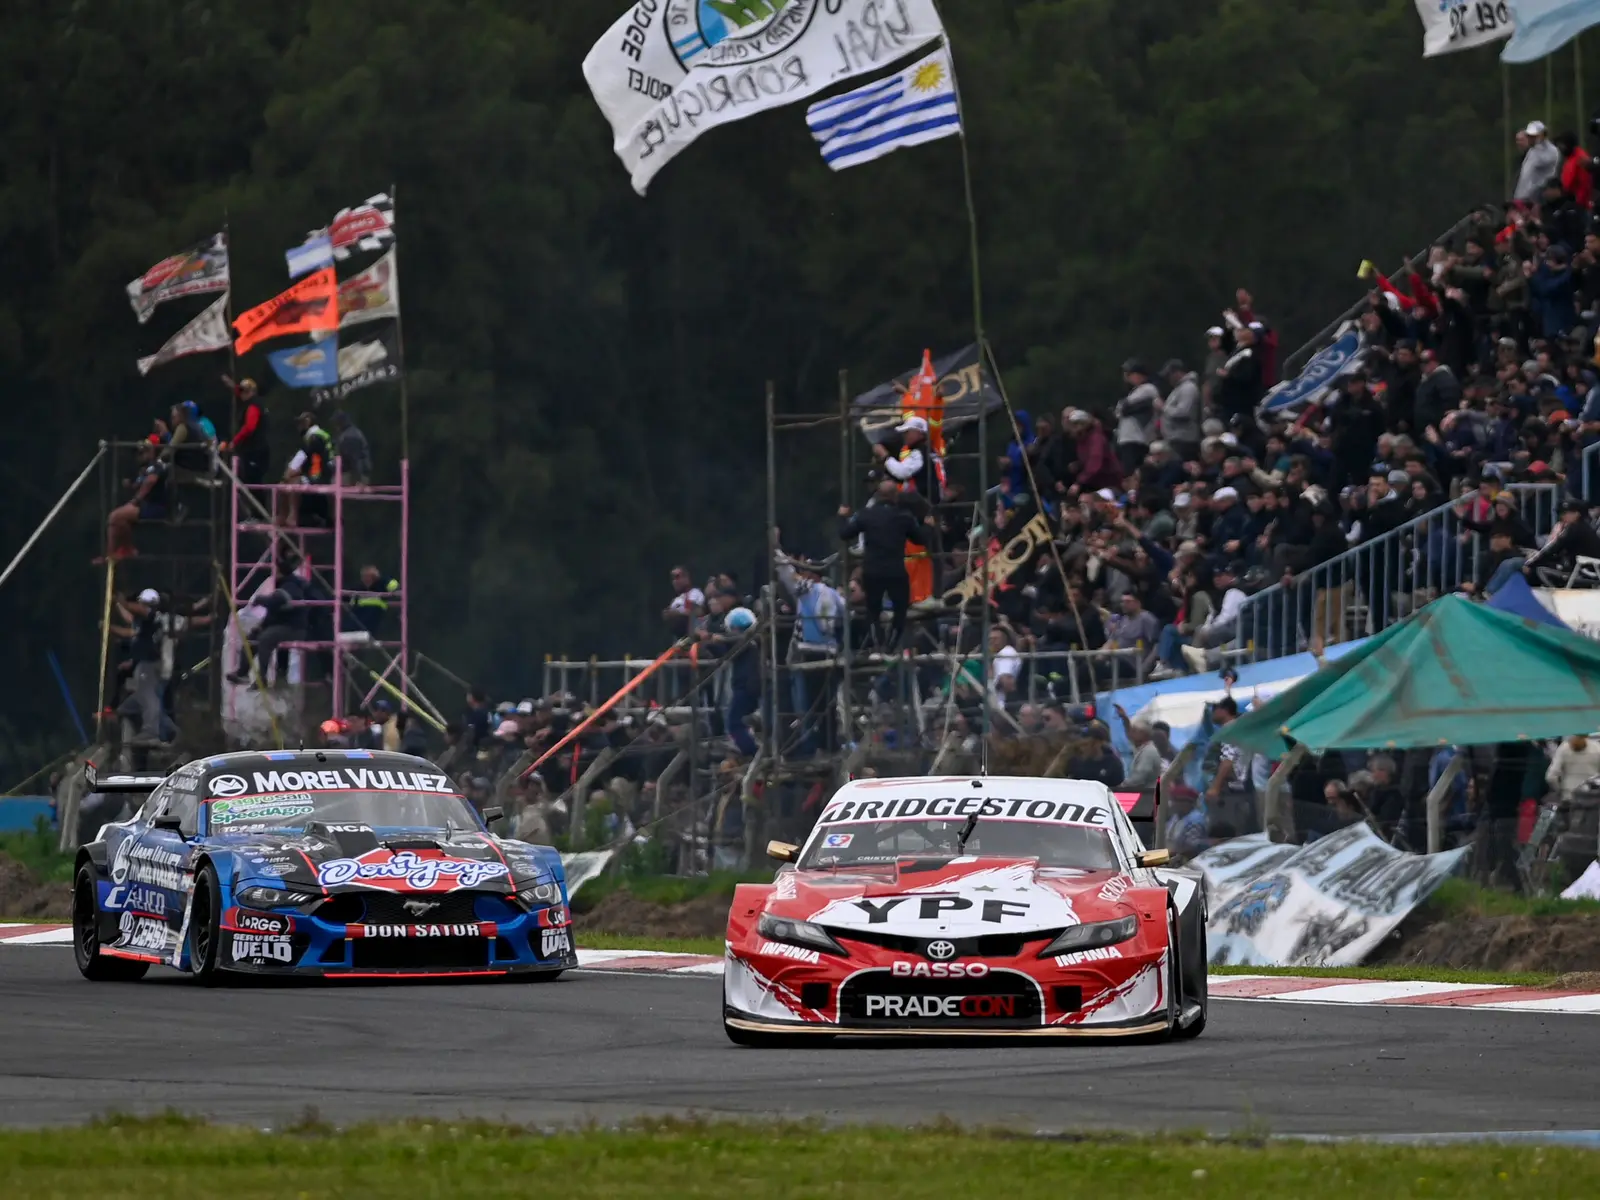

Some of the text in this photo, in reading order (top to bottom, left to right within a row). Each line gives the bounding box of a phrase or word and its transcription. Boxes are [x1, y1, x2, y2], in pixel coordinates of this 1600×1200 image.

[253, 768, 454, 793] MOREL VULLIEZ
[212, 806, 314, 824] SpeedAgro
[821, 796, 1110, 825] BRIDGESTONE
[327, 825, 374, 833] NCA
[319, 858, 406, 887] Don
[852, 897, 1031, 923] YPF
[233, 933, 292, 942] SERVICE
[364, 925, 480, 937] DON SATUR
[232, 941, 293, 962] WELD
[760, 942, 820, 964] INFINIA
[1054, 947, 1123, 967] INFINIA
[893, 961, 989, 977] BASSO
[866, 995, 1016, 1017] PRADECON
